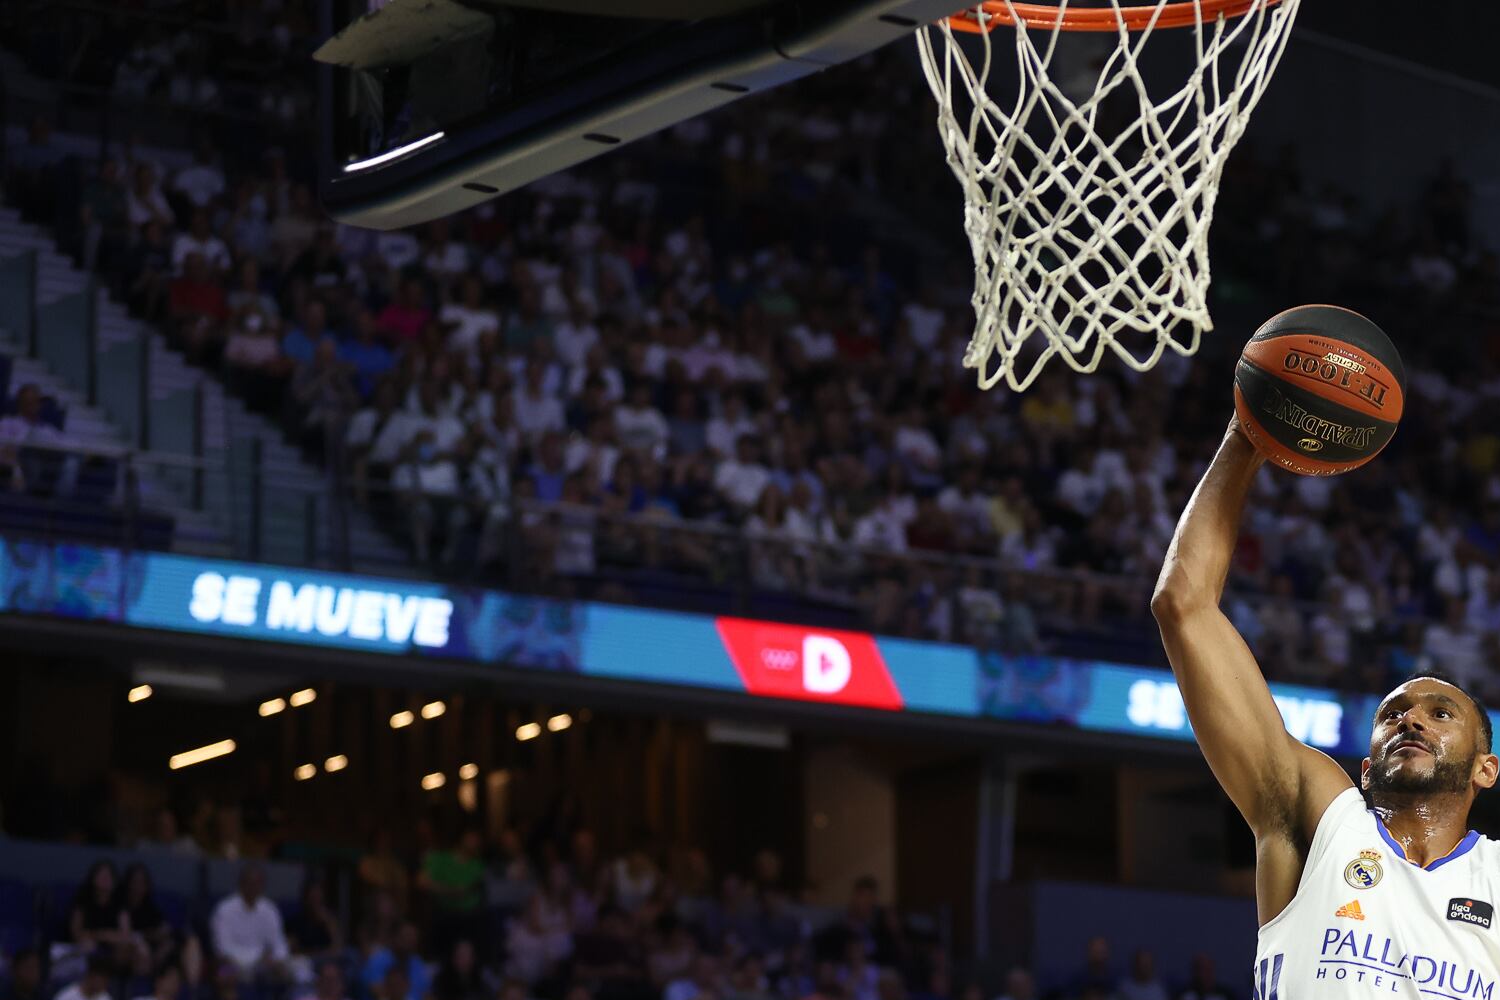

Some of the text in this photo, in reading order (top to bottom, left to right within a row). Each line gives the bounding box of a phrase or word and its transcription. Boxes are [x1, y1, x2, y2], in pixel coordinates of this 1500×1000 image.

[1284, 352, 1388, 406] TF-1000
[1264, 387, 1377, 449] SPALDING
[189, 571, 453, 648] SE MUEVE
[1126, 679, 1186, 730] SE
[1450, 911, 1489, 926] endesa
[1451, 903, 1471, 913] liga
[1316, 967, 1399, 993] HOTEL
